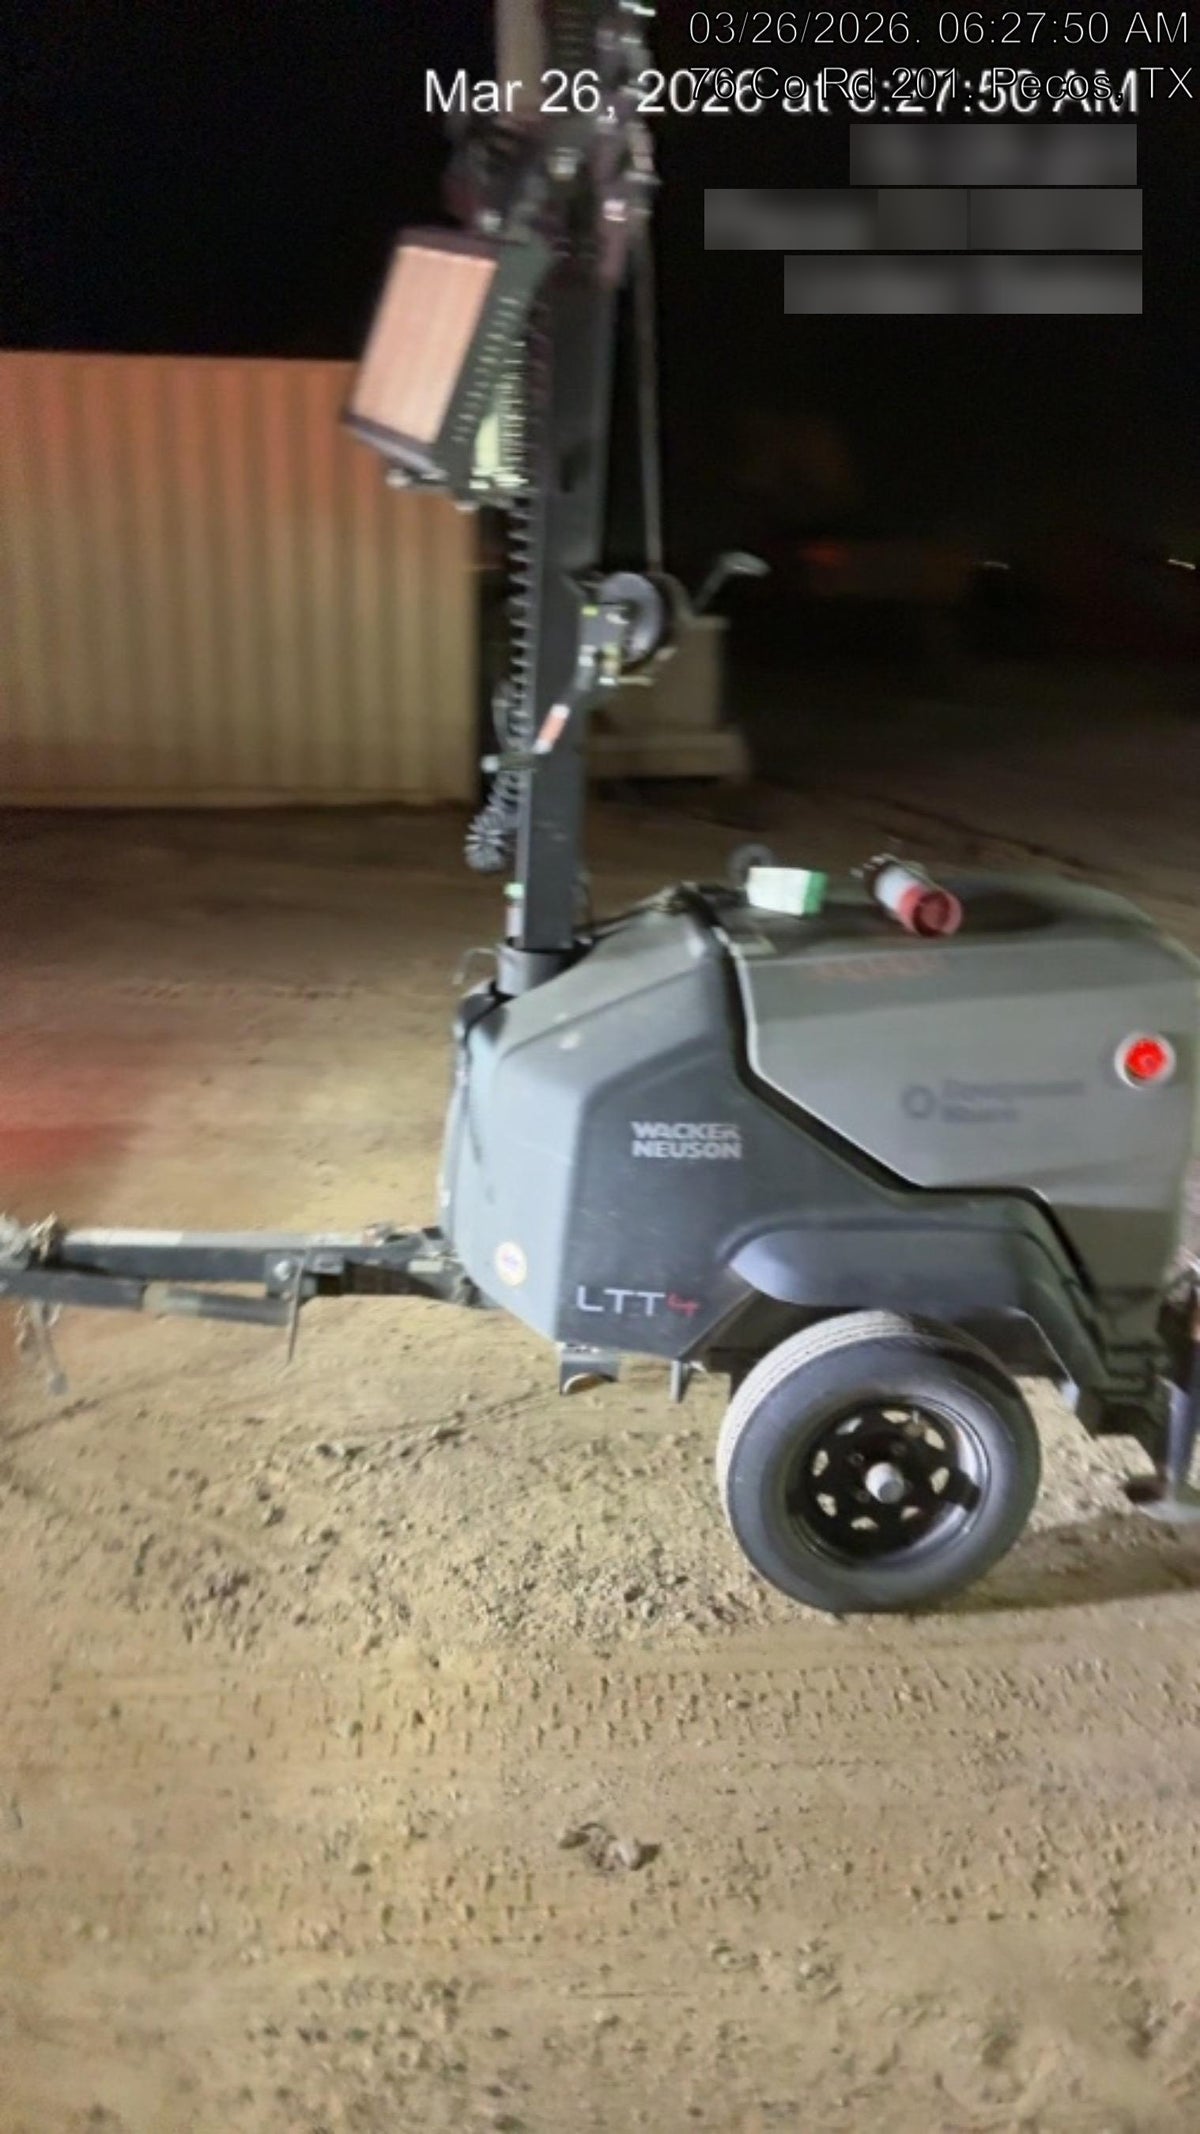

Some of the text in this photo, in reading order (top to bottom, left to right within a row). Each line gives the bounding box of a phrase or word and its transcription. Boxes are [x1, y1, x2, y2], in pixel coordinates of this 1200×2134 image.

[631, 1121, 741, 1139] WACKER
[631, 1140, 743, 1159] NEUSON
[576, 1285, 699, 1317] LTT4
